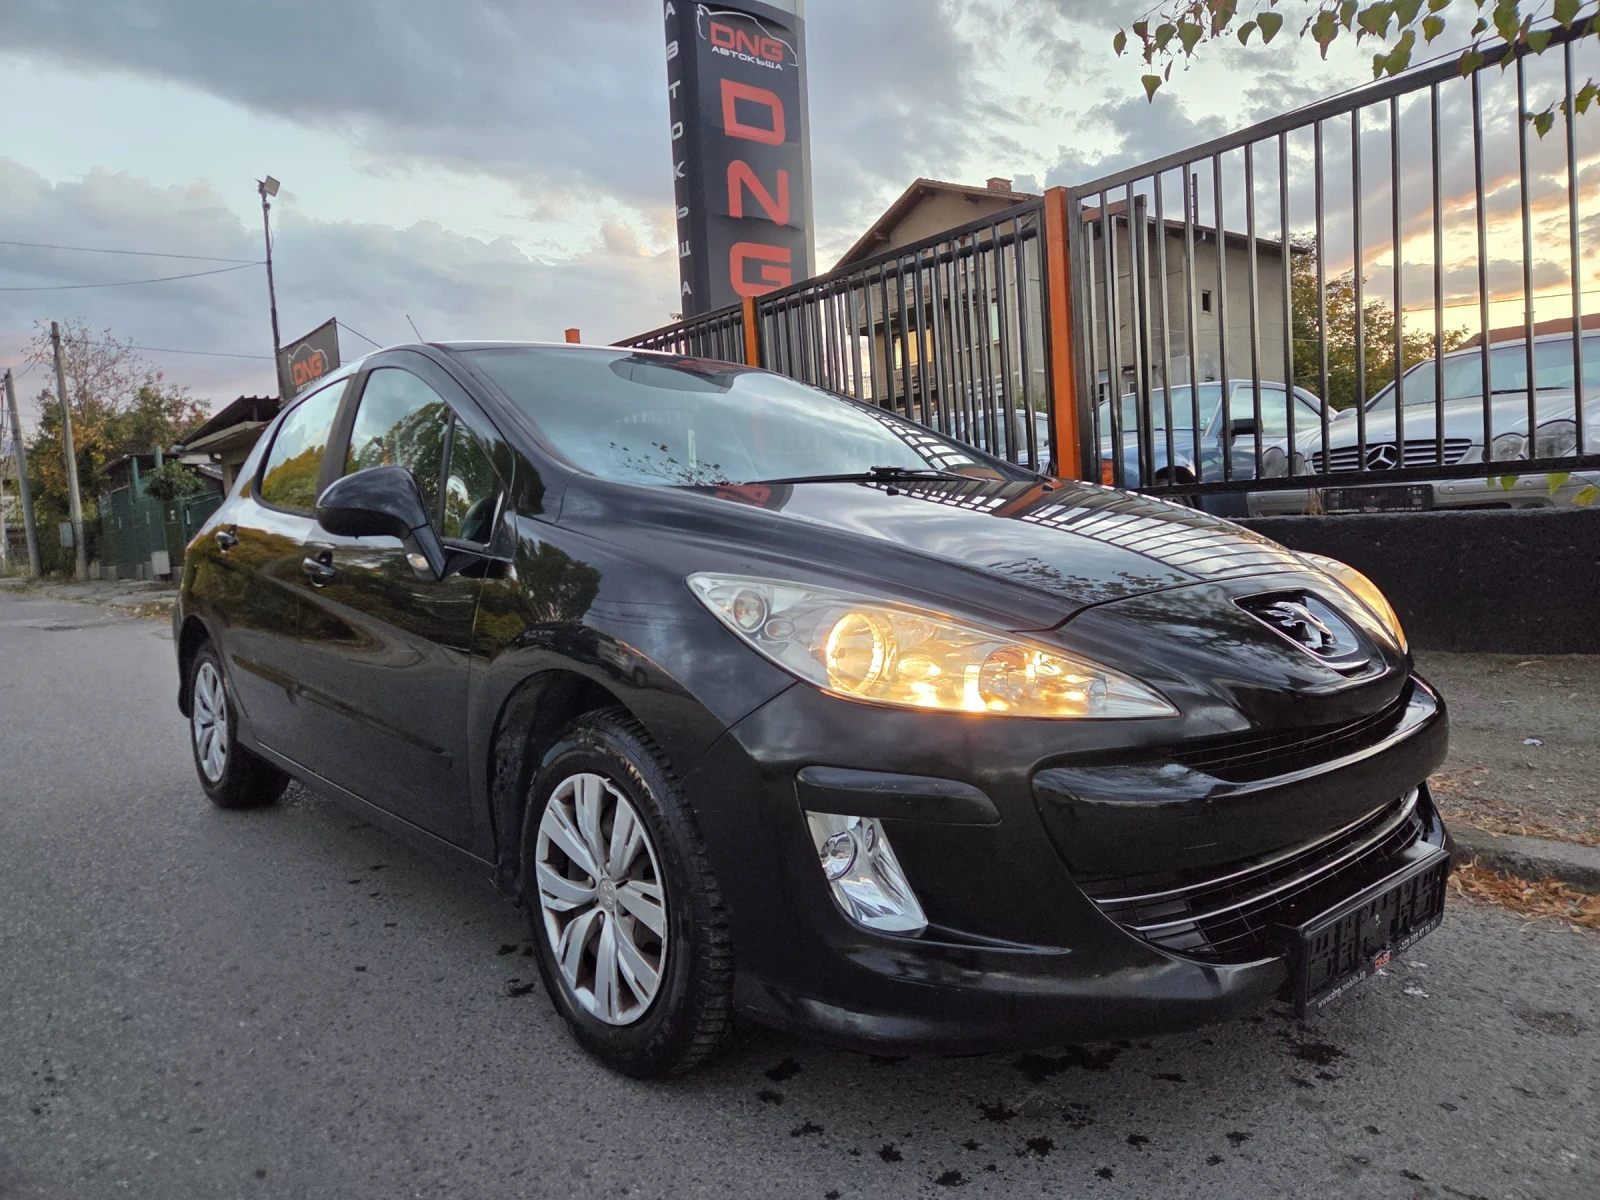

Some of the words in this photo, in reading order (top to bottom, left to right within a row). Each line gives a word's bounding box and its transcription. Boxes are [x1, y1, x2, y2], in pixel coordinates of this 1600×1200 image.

[709, 21, 783, 63] DNG
[720, 78, 792, 299] DNG
[293, 352, 322, 386] DNG
